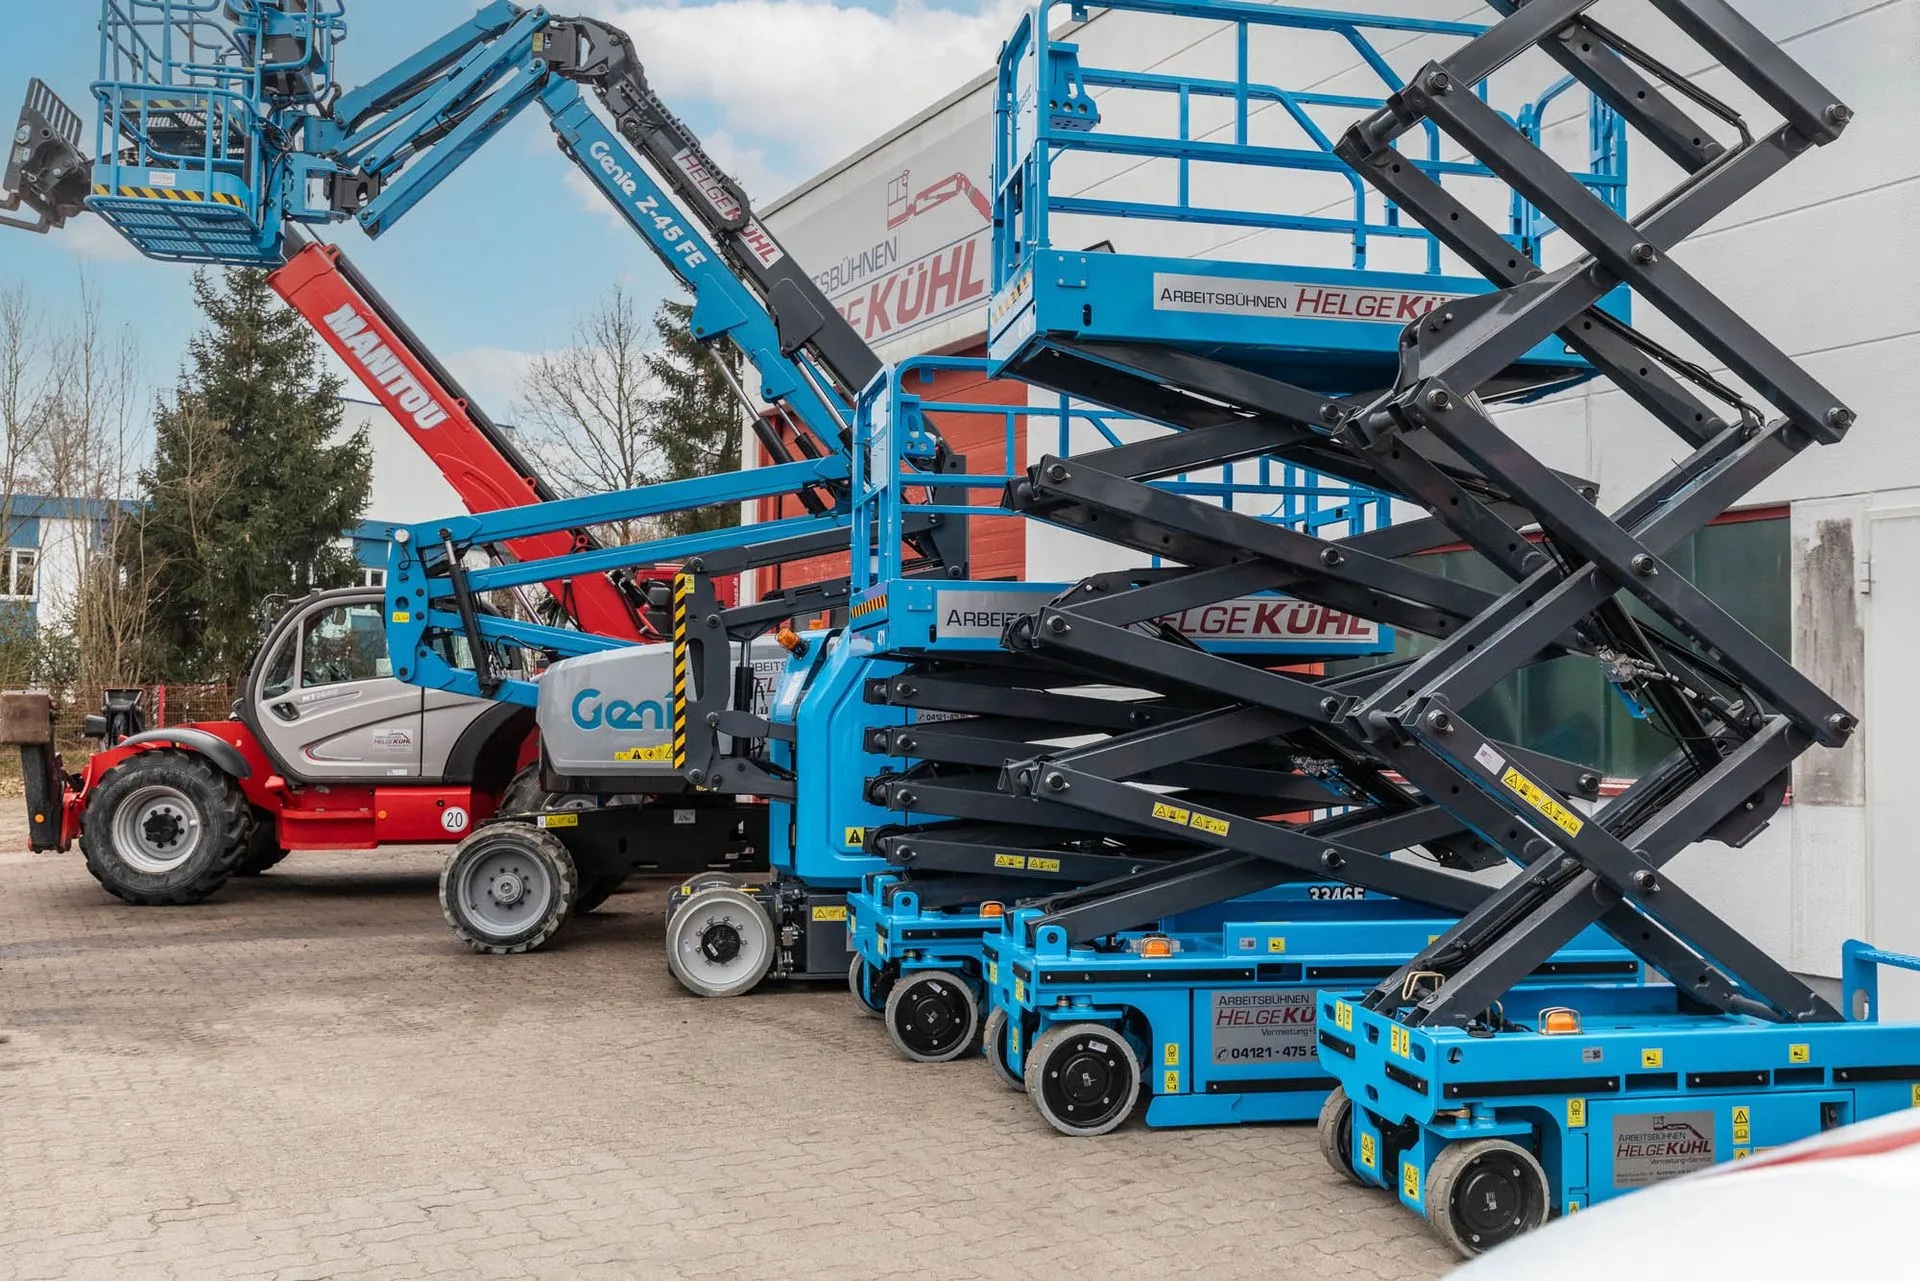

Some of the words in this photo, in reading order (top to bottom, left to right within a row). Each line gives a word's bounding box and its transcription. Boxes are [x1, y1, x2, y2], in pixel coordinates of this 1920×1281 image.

[590, 141, 637, 197] Genie
[635, 195, 685, 241] Z-45
[674, 240, 708, 269] FE
[1161, 288, 1287, 309] ARBEITSBÜHNEN
[323, 303, 449, 430] MANITOU
[447, 812, 463, 828] 20
[1219, 995, 1310, 1006] ARBEITSBÜHNEN
[1231, 1048, 1272, 1059] 04121
[1282, 1046, 1306, 1057] 475
[1616, 1140, 1712, 1157] HELGEKÜHL
